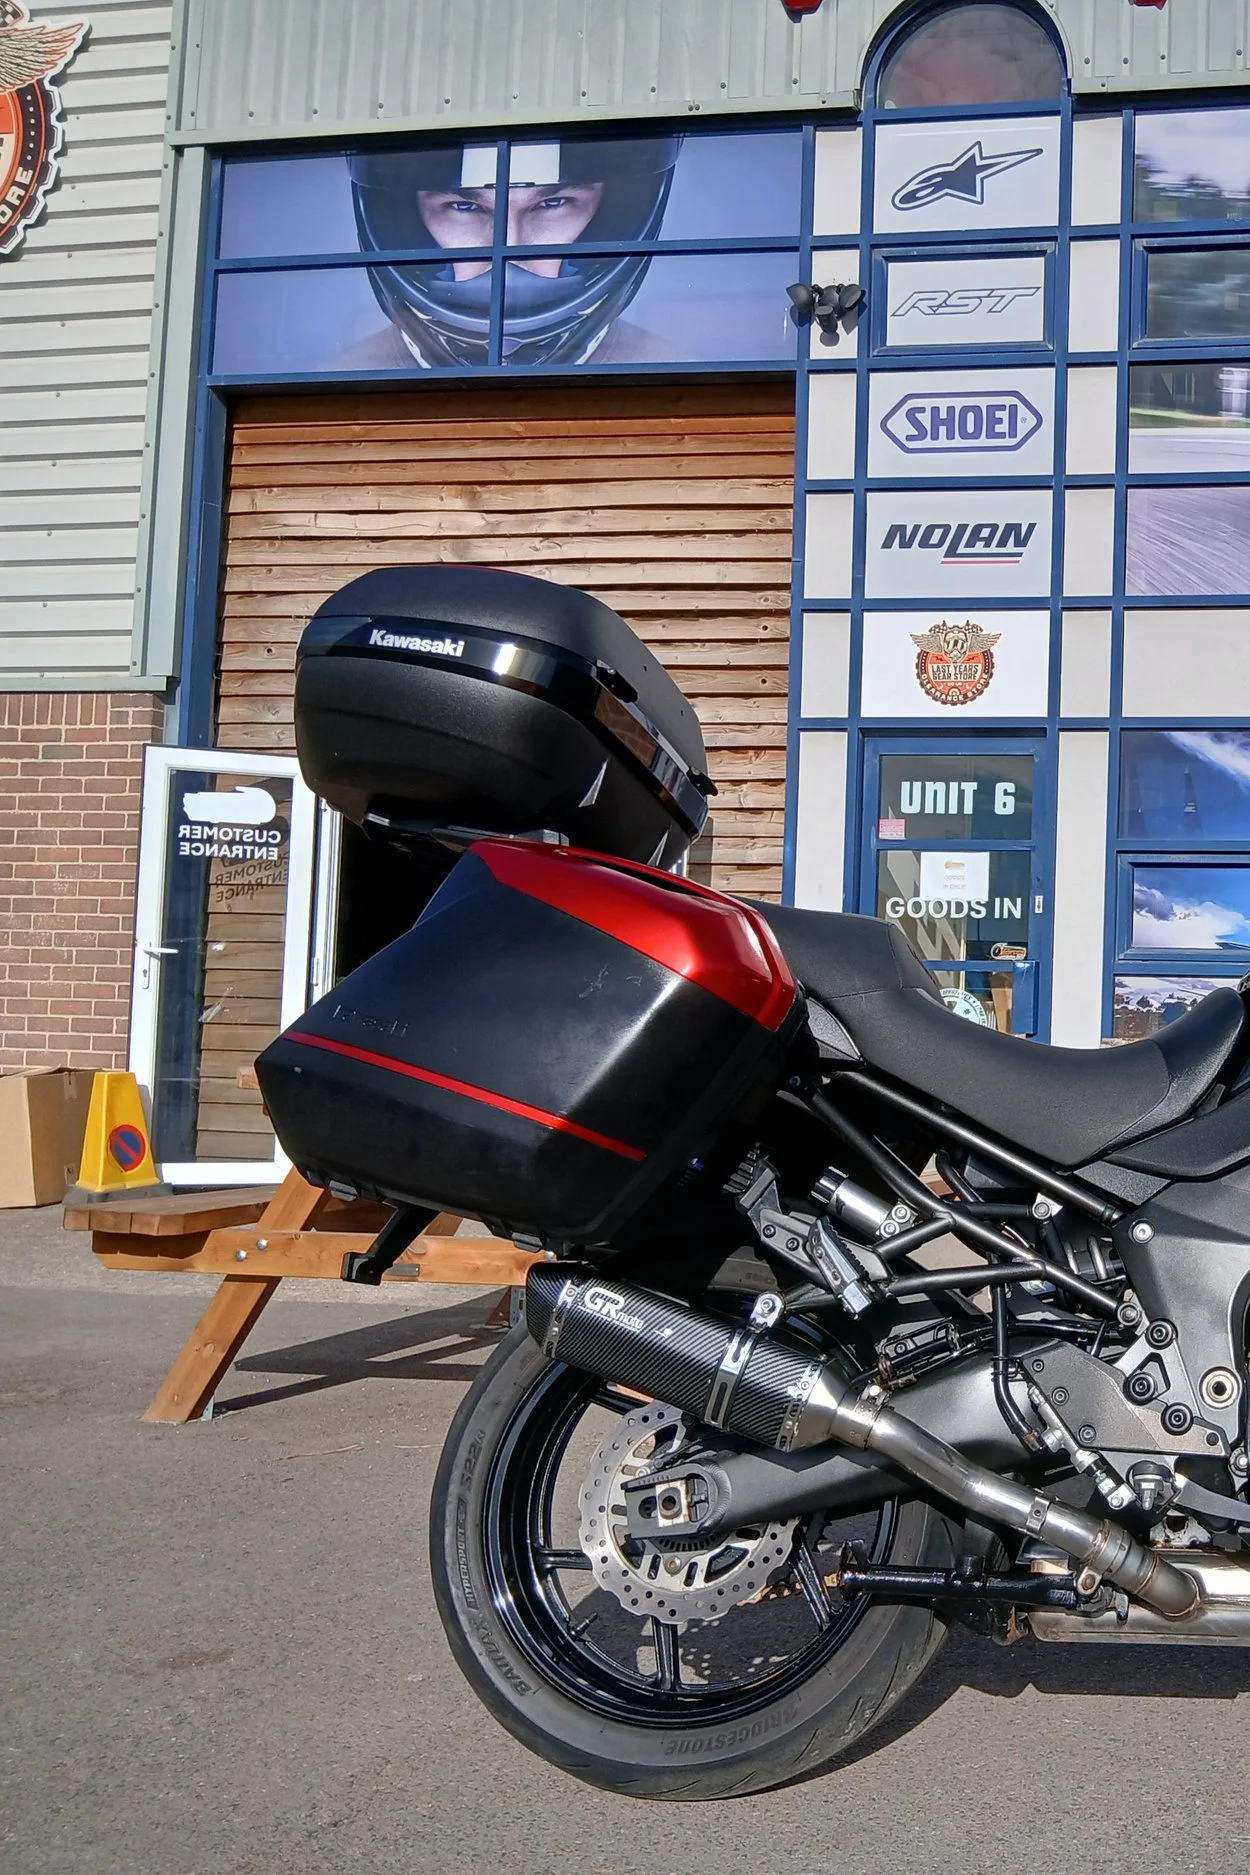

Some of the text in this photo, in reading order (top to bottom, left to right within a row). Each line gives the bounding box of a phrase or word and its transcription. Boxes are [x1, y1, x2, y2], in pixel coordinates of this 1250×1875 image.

[891, 287, 1041, 317] RST
[905, 404, 1018, 442] SHOEI
[880, 522, 1037, 558] NOLAN
[369, 629, 464, 657] Kawasaki
[931, 664, 979, 673] LAST YEARS
[932, 673, 977, 681] GEAR STORE
[994, 782, 1016, 816] 6
[886, 897, 1022, 919] GOODS IN
